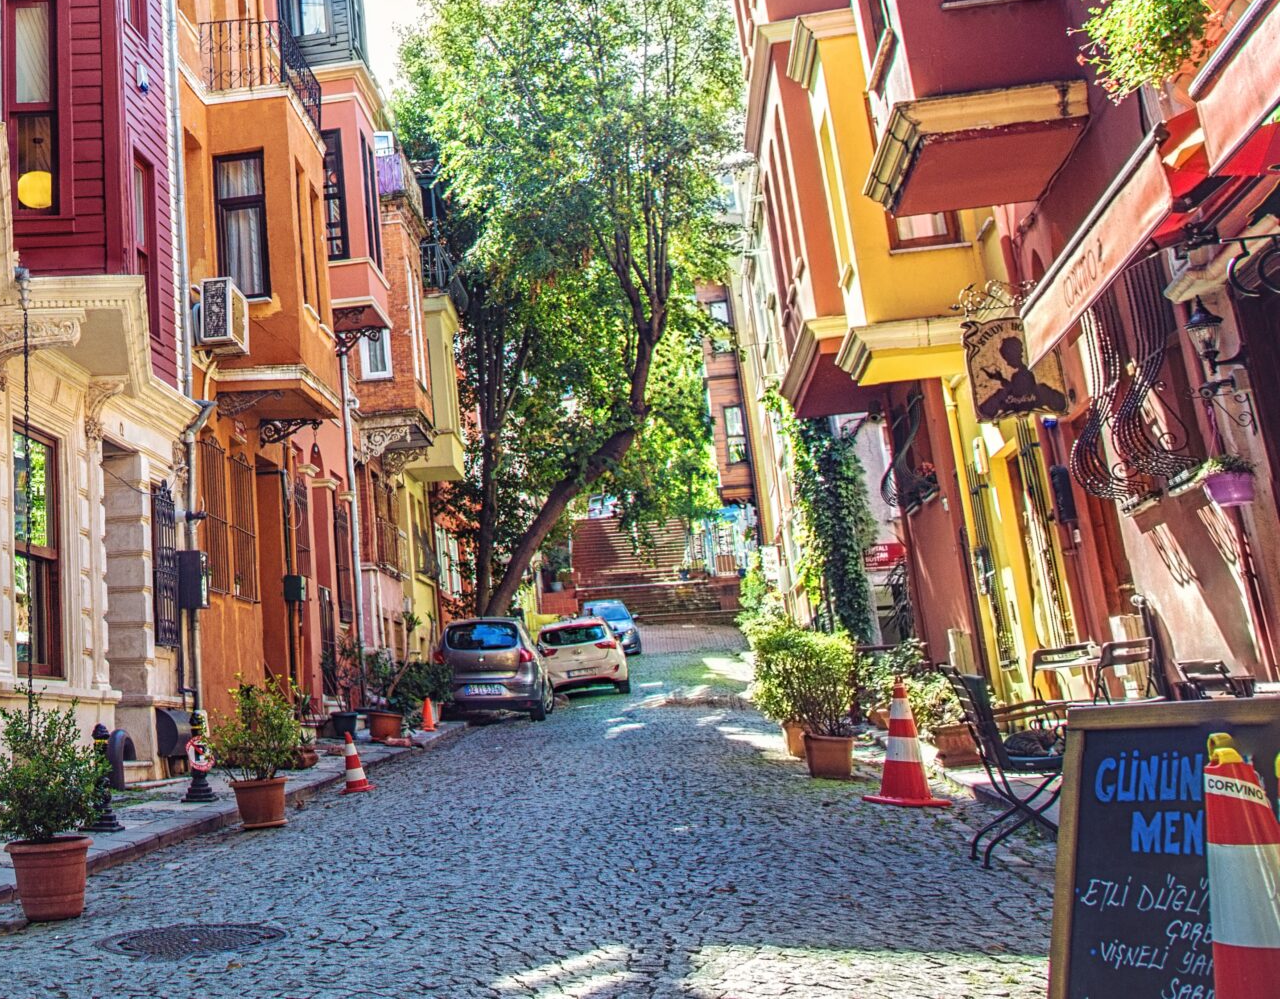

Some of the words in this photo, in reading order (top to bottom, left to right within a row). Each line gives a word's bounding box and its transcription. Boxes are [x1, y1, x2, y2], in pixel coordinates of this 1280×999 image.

[977, 323, 1004, 346] STUDY
[1011, 322, 1024, 332] HO
[1094, 750, 1204, 802] GÜNÜN
[1207, 778, 1264, 800] CORVINO
[1131, 811, 1204, 856] MEN
[1166, 920, 1213, 950] ÇORB
